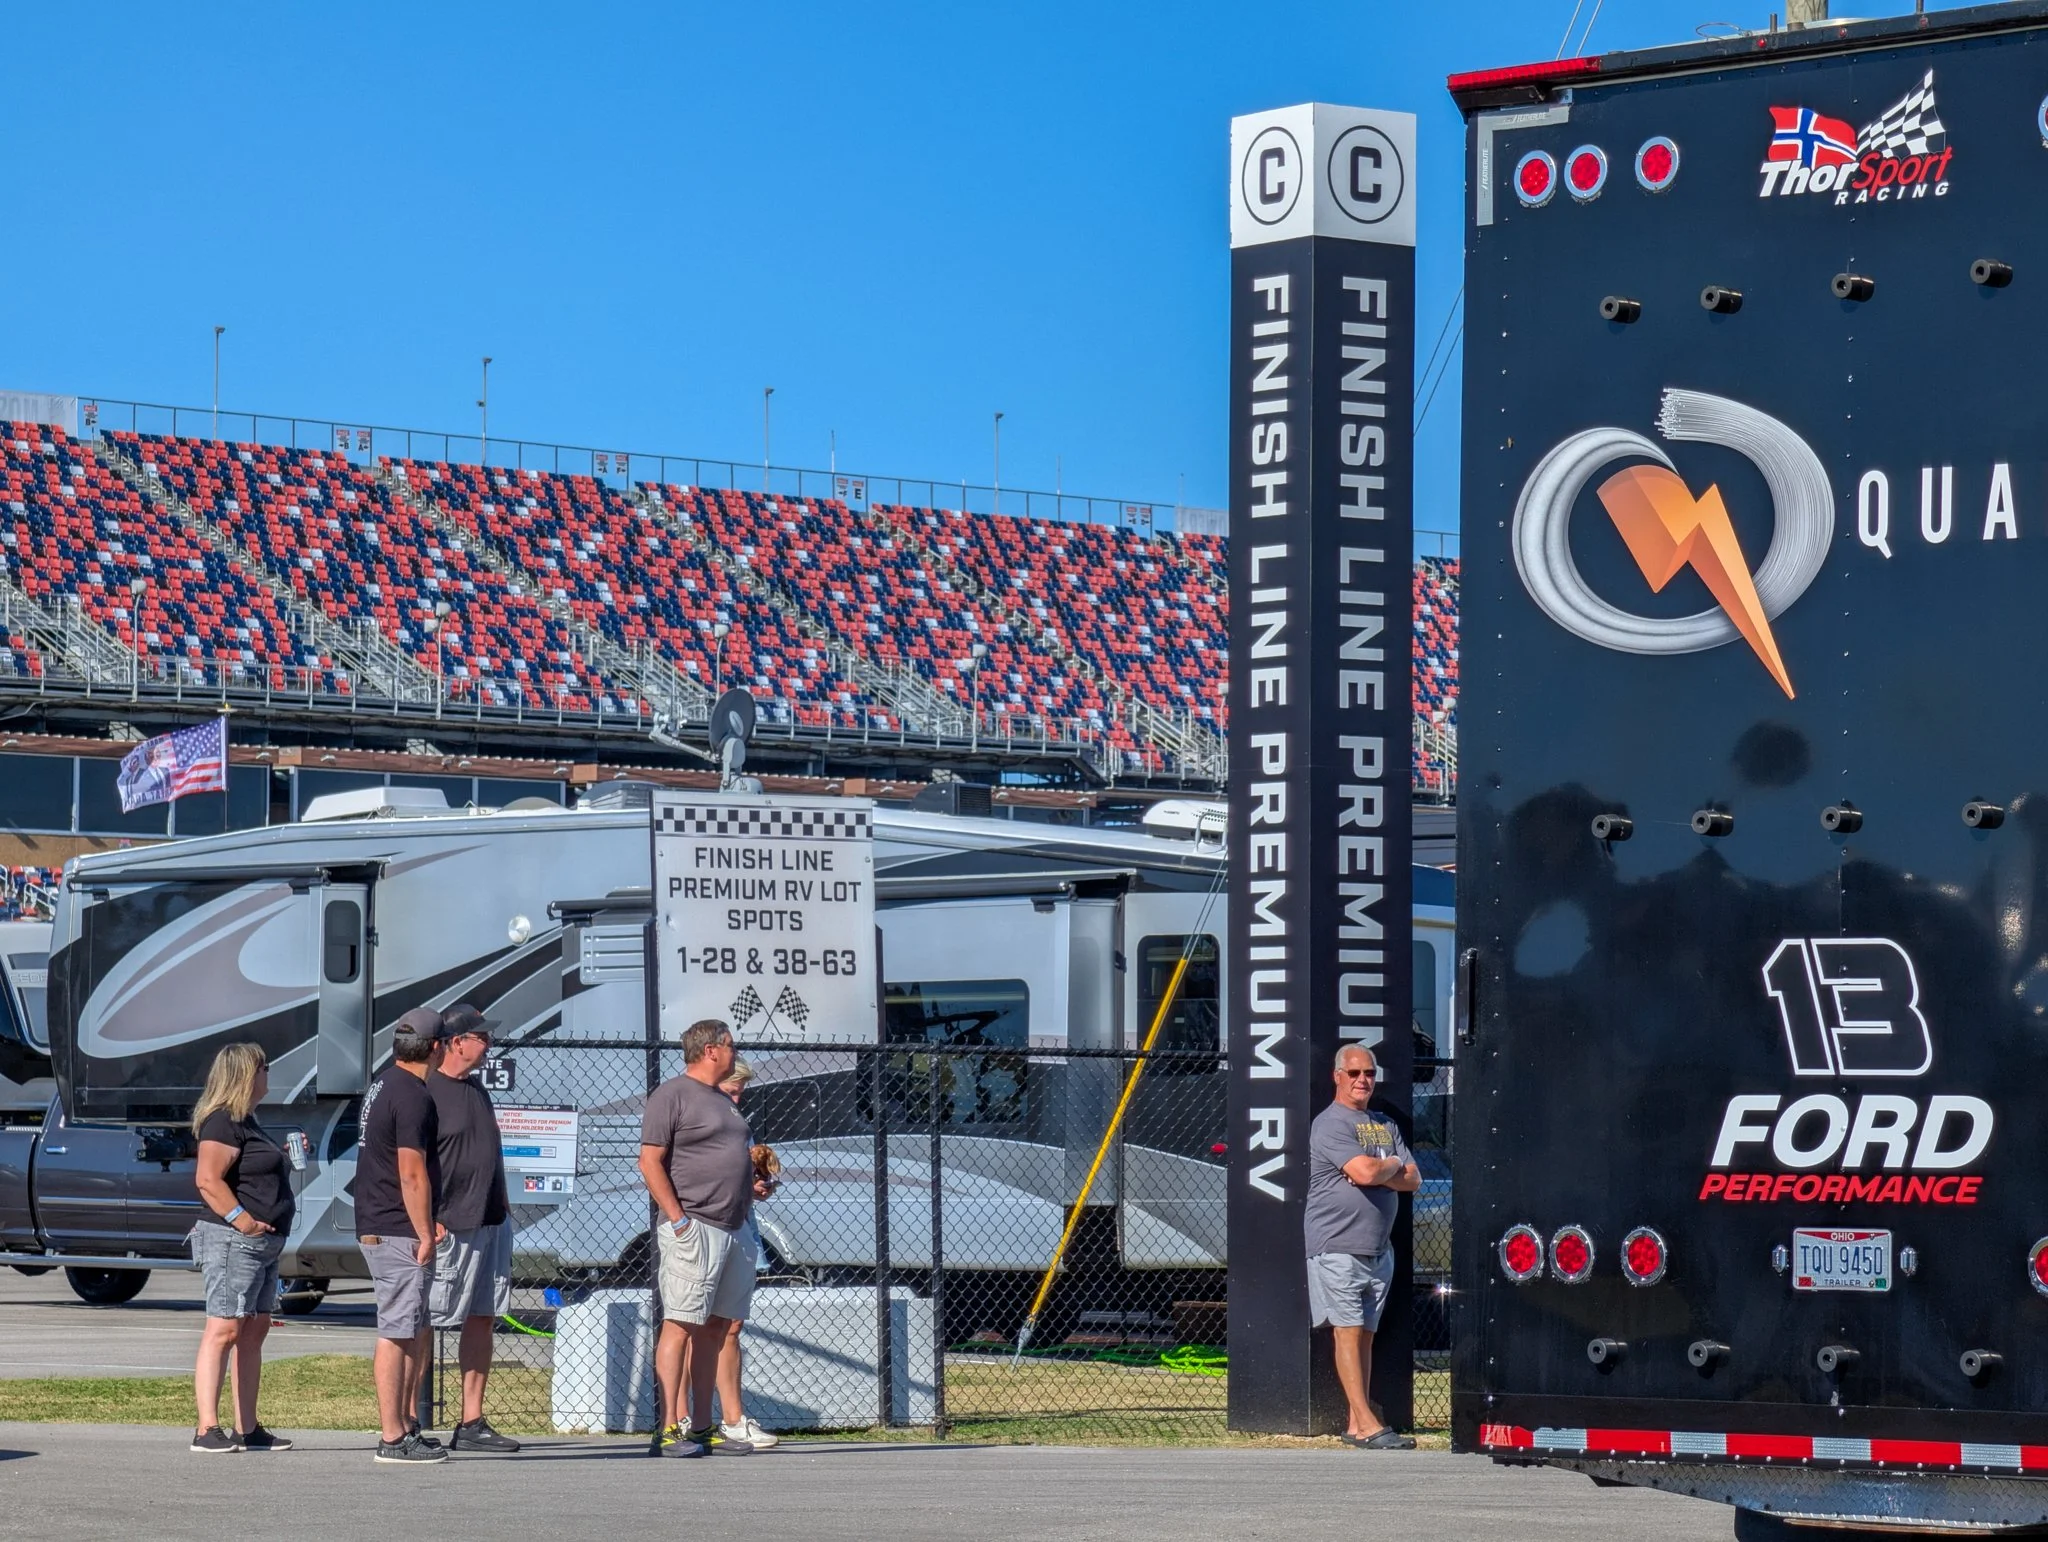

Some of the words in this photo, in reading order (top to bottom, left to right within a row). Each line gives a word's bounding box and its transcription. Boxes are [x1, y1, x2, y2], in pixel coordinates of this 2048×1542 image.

[1259, 146, 1286, 205] C
[1350, 145, 1382, 204] C
[1759, 145, 1952, 198] ThorSport
[1834, 181, 1950, 206] RACING
[1251, 274, 1290, 518] FINISH
[1339, 276, 1387, 520] FINISH
[854, 488, 862, 500] E
[1858, 463, 2018, 559] QUA
[1251, 544, 1287, 708] LINE
[1339, 546, 1385, 710] LINE
[695, 847, 773, 870] FINISH
[782, 849, 834, 871] LINE
[669, 877, 776, 900] PREMIUM
[785, 880, 813, 901] RV
[821, 881, 861, 902] LOT
[1249, 732, 1287, 1079] PREMIUM
[727, 909, 803, 931] SPOTS
[677, 946, 737, 973] 1-28
[746, 947, 764, 975] &
[773, 948, 857, 976] 38-63
[1762, 938, 1933, 1076] 13
[1249, 1107, 1286, 1202] RV
[1710, 1094, 1994, 1168] FORD
[1699, 1174, 1983, 1203] PERFORMANCE
[1800, 1245, 1833, 1274] TQU
[1840, 1246, 1883, 1275] 9450
[1830, 1232, 1855, 1241] OHIO
[1824, 1278, 1861, 1287] TRAILER
